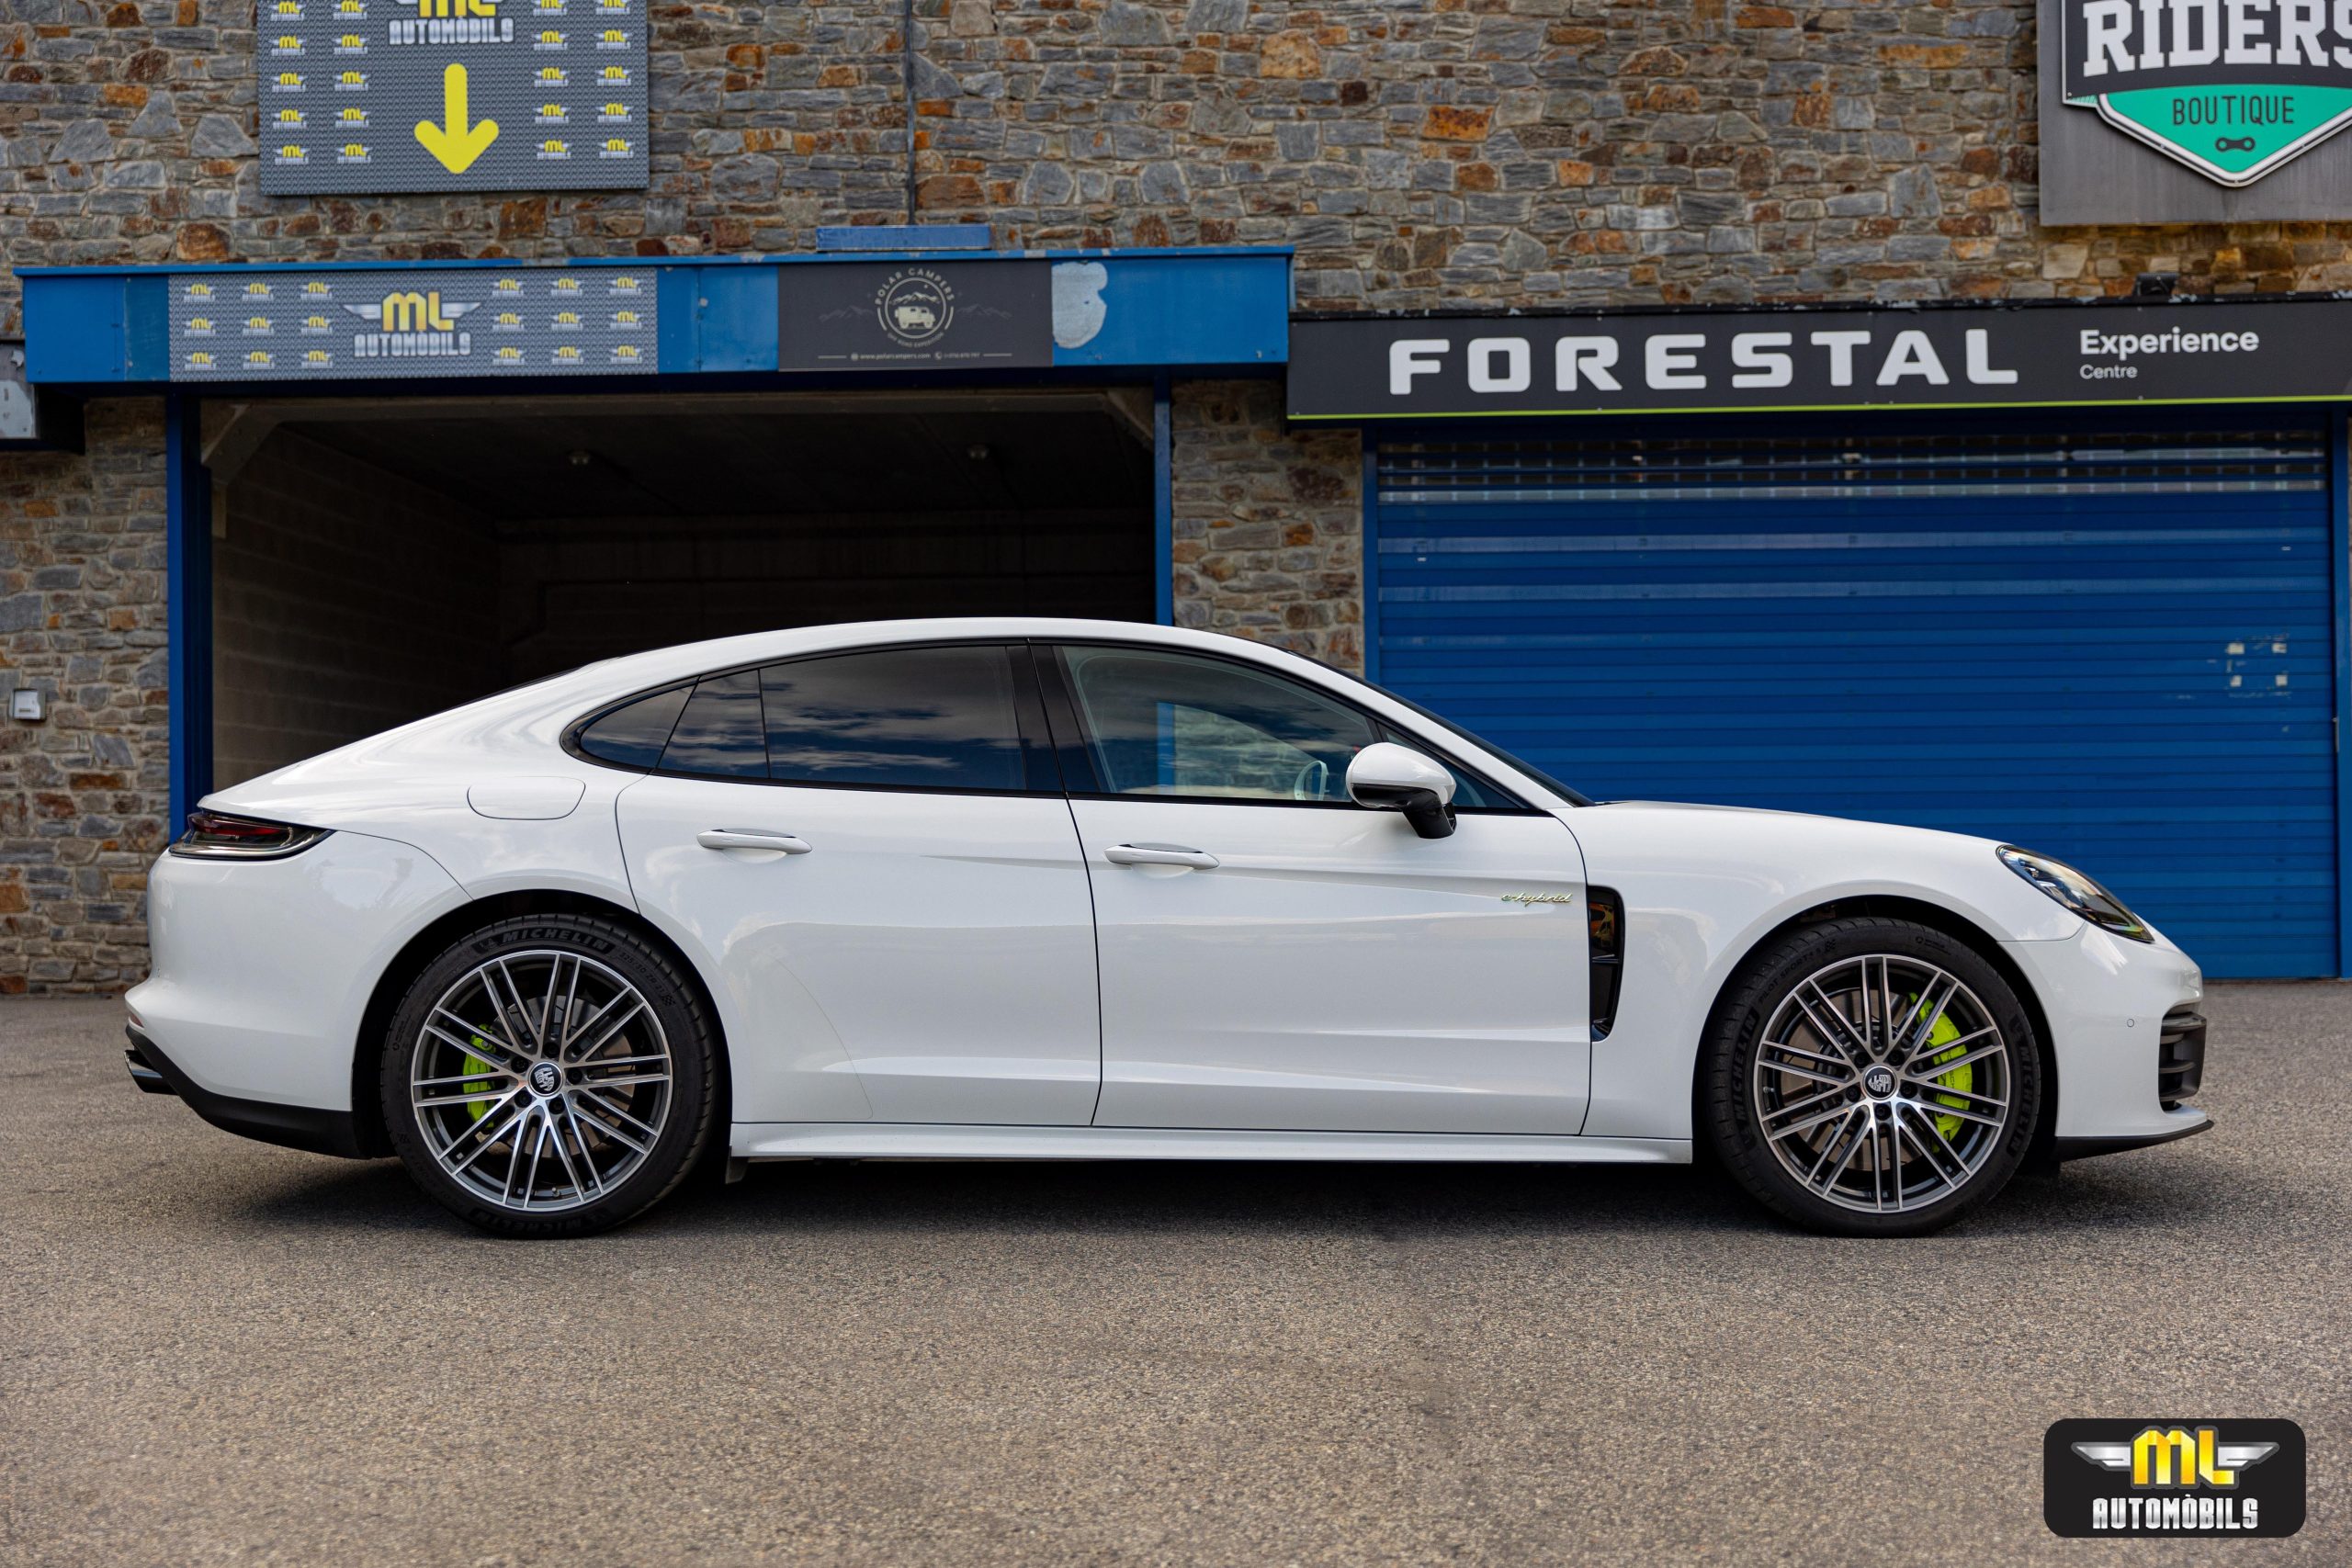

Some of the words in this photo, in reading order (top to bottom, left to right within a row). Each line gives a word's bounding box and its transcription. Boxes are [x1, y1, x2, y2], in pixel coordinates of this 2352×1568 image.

[2172, 96, 2295, 126] BOUTIQUE
[875, 271, 902, 305] POLAR
[908, 267, 955, 300] CAMPERS
[382, 291, 455, 332] ML
[1389, 329, 2018, 395] FORESTAL
[2080, 326, 2259, 361] Experience
[2080, 364, 2138, 379] Centre
[503, 928, 607, 952] MICHELIN
[1732, 1016, 1758, 1123] MICHELIN
[2010, 1045, 2032, 1154] MICHELIN
